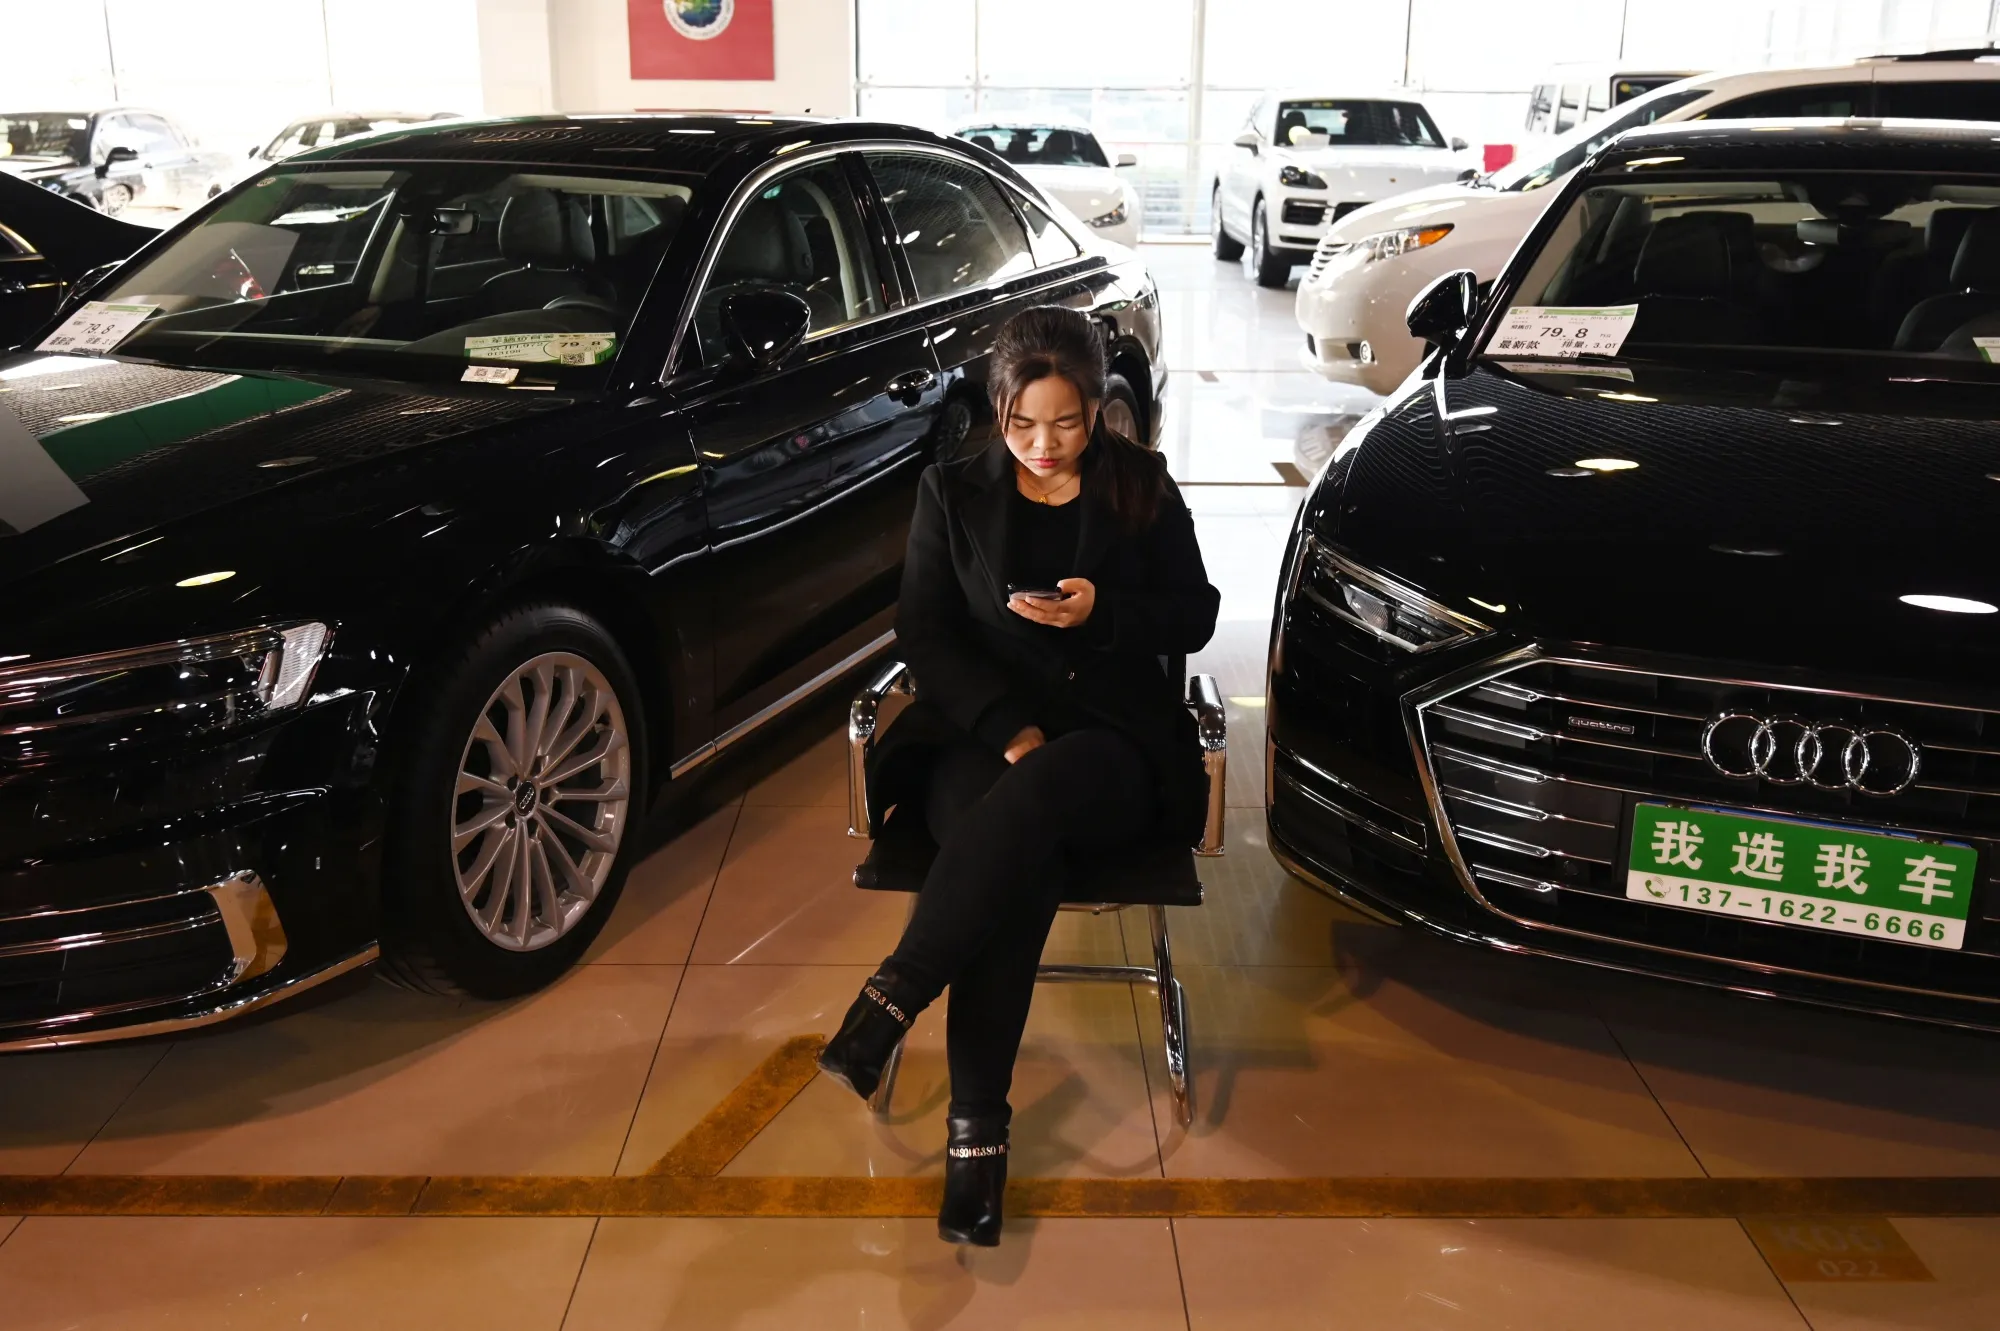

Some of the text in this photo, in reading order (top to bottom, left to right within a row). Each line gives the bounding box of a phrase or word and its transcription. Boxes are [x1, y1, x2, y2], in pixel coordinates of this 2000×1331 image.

[80, 323, 115, 335] 79.8
[1539, 327, 1588, 338] 79.8
[1498, 340, 1540, 349] 最新款
[1571, 718, 1631, 733] quattro
[1650, 820, 1957, 906] 我选我车
[1679, 884, 1946, 941] 137-1622-6666
[1816, 1259, 1889, 1278] 022
